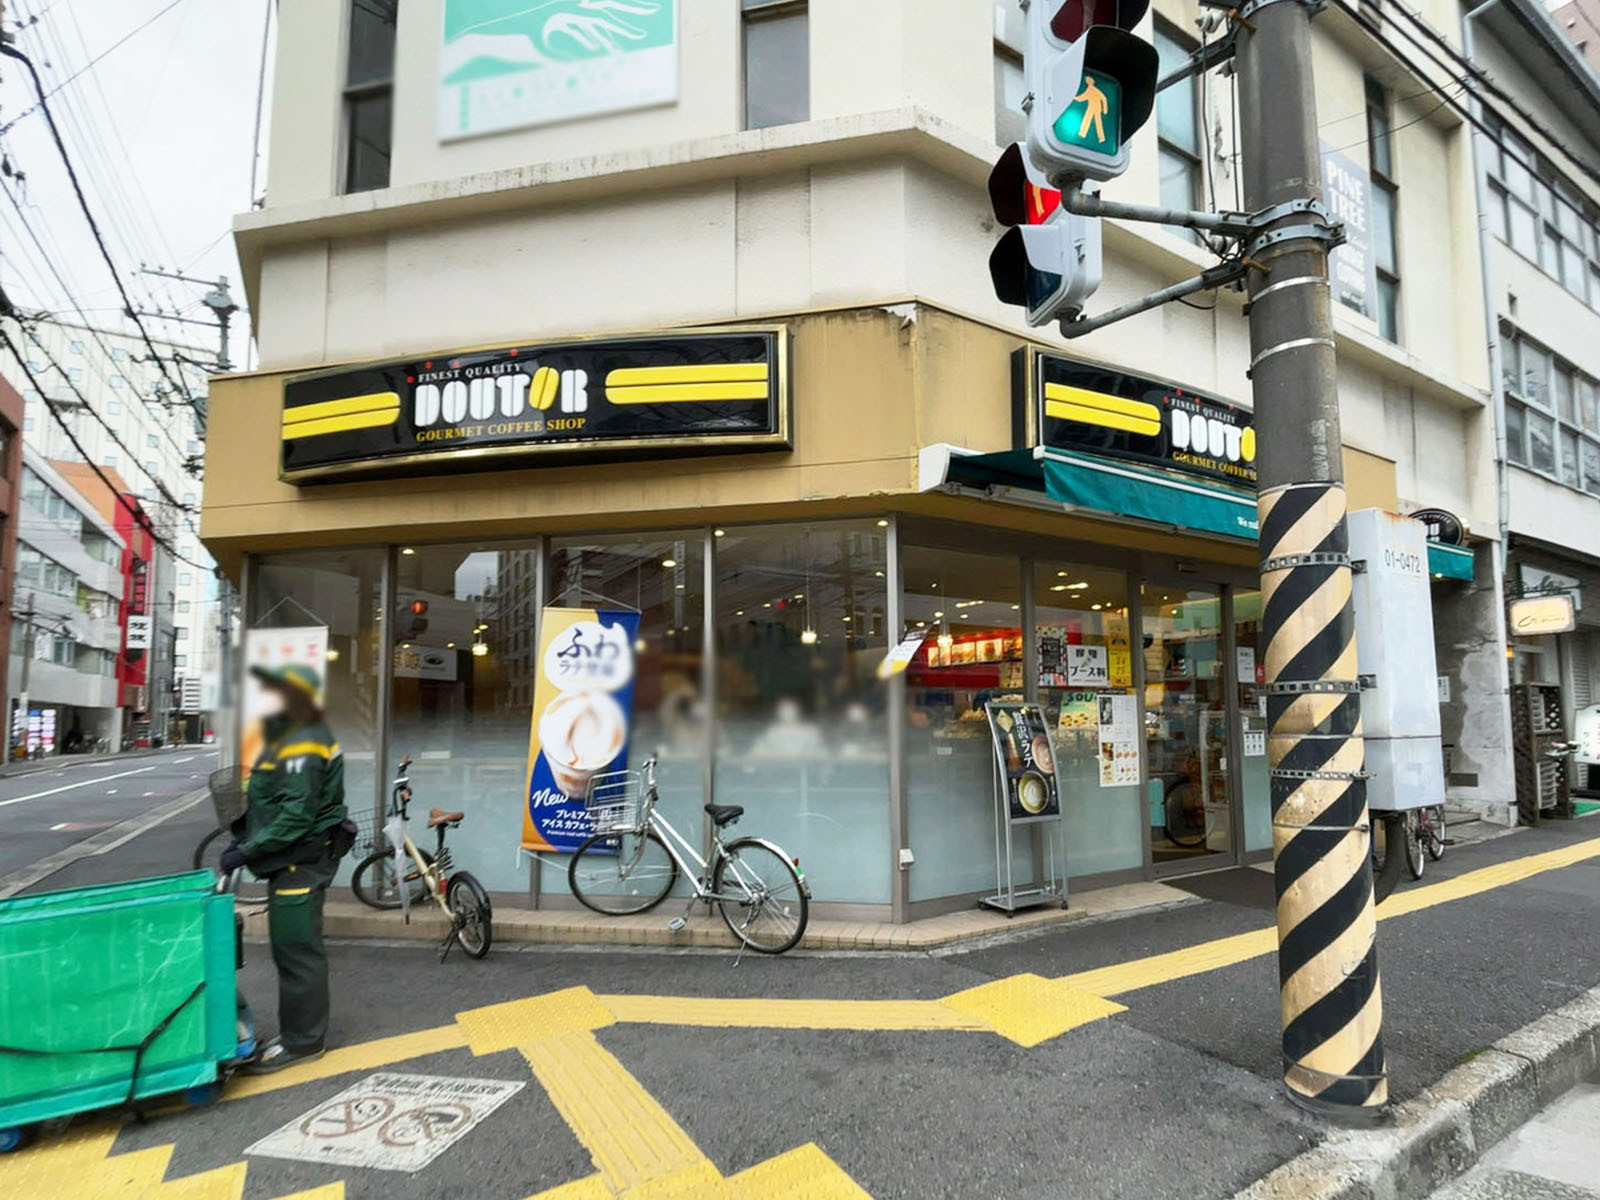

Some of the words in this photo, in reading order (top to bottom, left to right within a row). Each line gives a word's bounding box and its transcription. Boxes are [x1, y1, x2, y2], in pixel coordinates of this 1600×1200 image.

[1326, 159, 1365, 206] PINE
[1328, 187, 1366, 233] TREE
[418, 369, 461, 383] FINEST
[465, 362, 523, 377] QUALITY
[414, 366, 588, 427] DOUTOR
[1171, 398, 1200, 412] FINEST
[1203, 407, 1236, 424] QUALITY
[416, 425, 483, 442] GOURMET
[487, 420, 543, 434] COFFEE
[546, 417, 586, 431] SHOP
[1172, 409, 1256, 462] DOUTO
[1172, 450, 1216, 470] GOURMET
[1063, 692, 1098, 706] SOU
[532, 787, 569, 808] New
